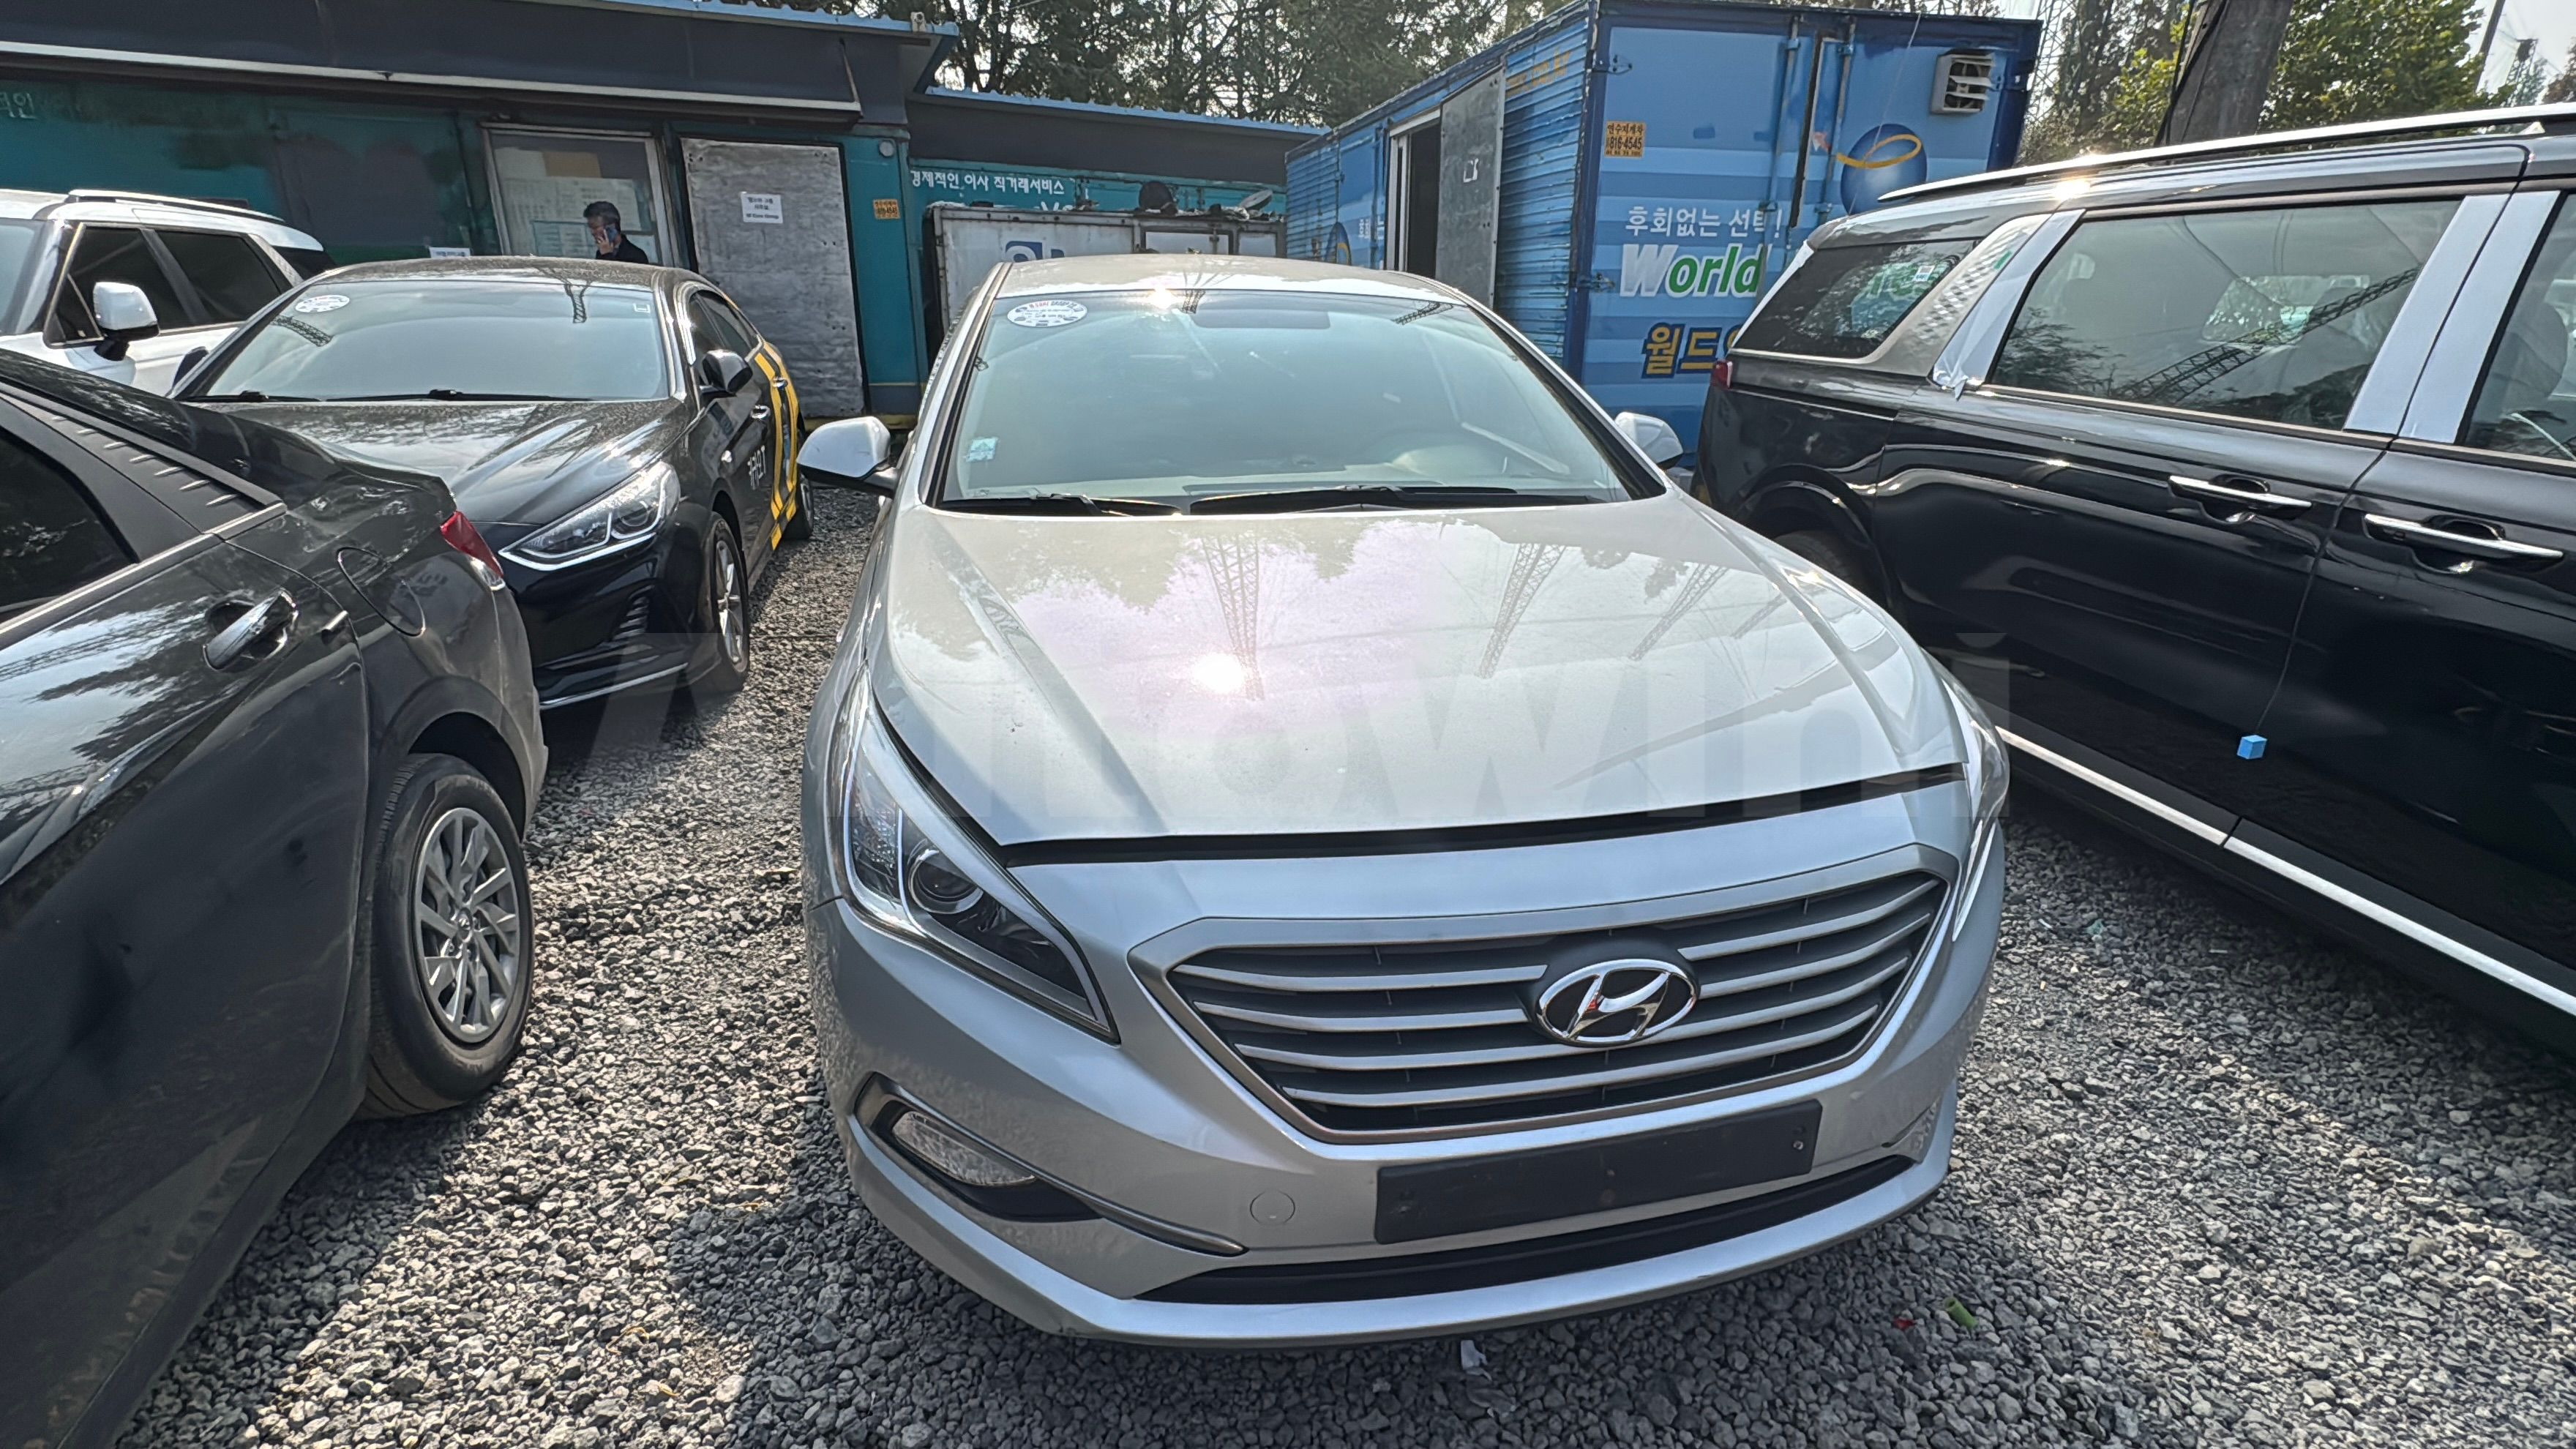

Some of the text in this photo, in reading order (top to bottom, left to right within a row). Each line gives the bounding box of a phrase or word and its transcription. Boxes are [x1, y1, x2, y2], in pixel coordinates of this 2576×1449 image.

[910, 170, 1065, 195] 경제적인 이사 직거래서비스
[1625, 203, 1721, 238] 후회없는
[1620, 243, 1772, 298] World
[1641, 322, 1741, 378] 월드
